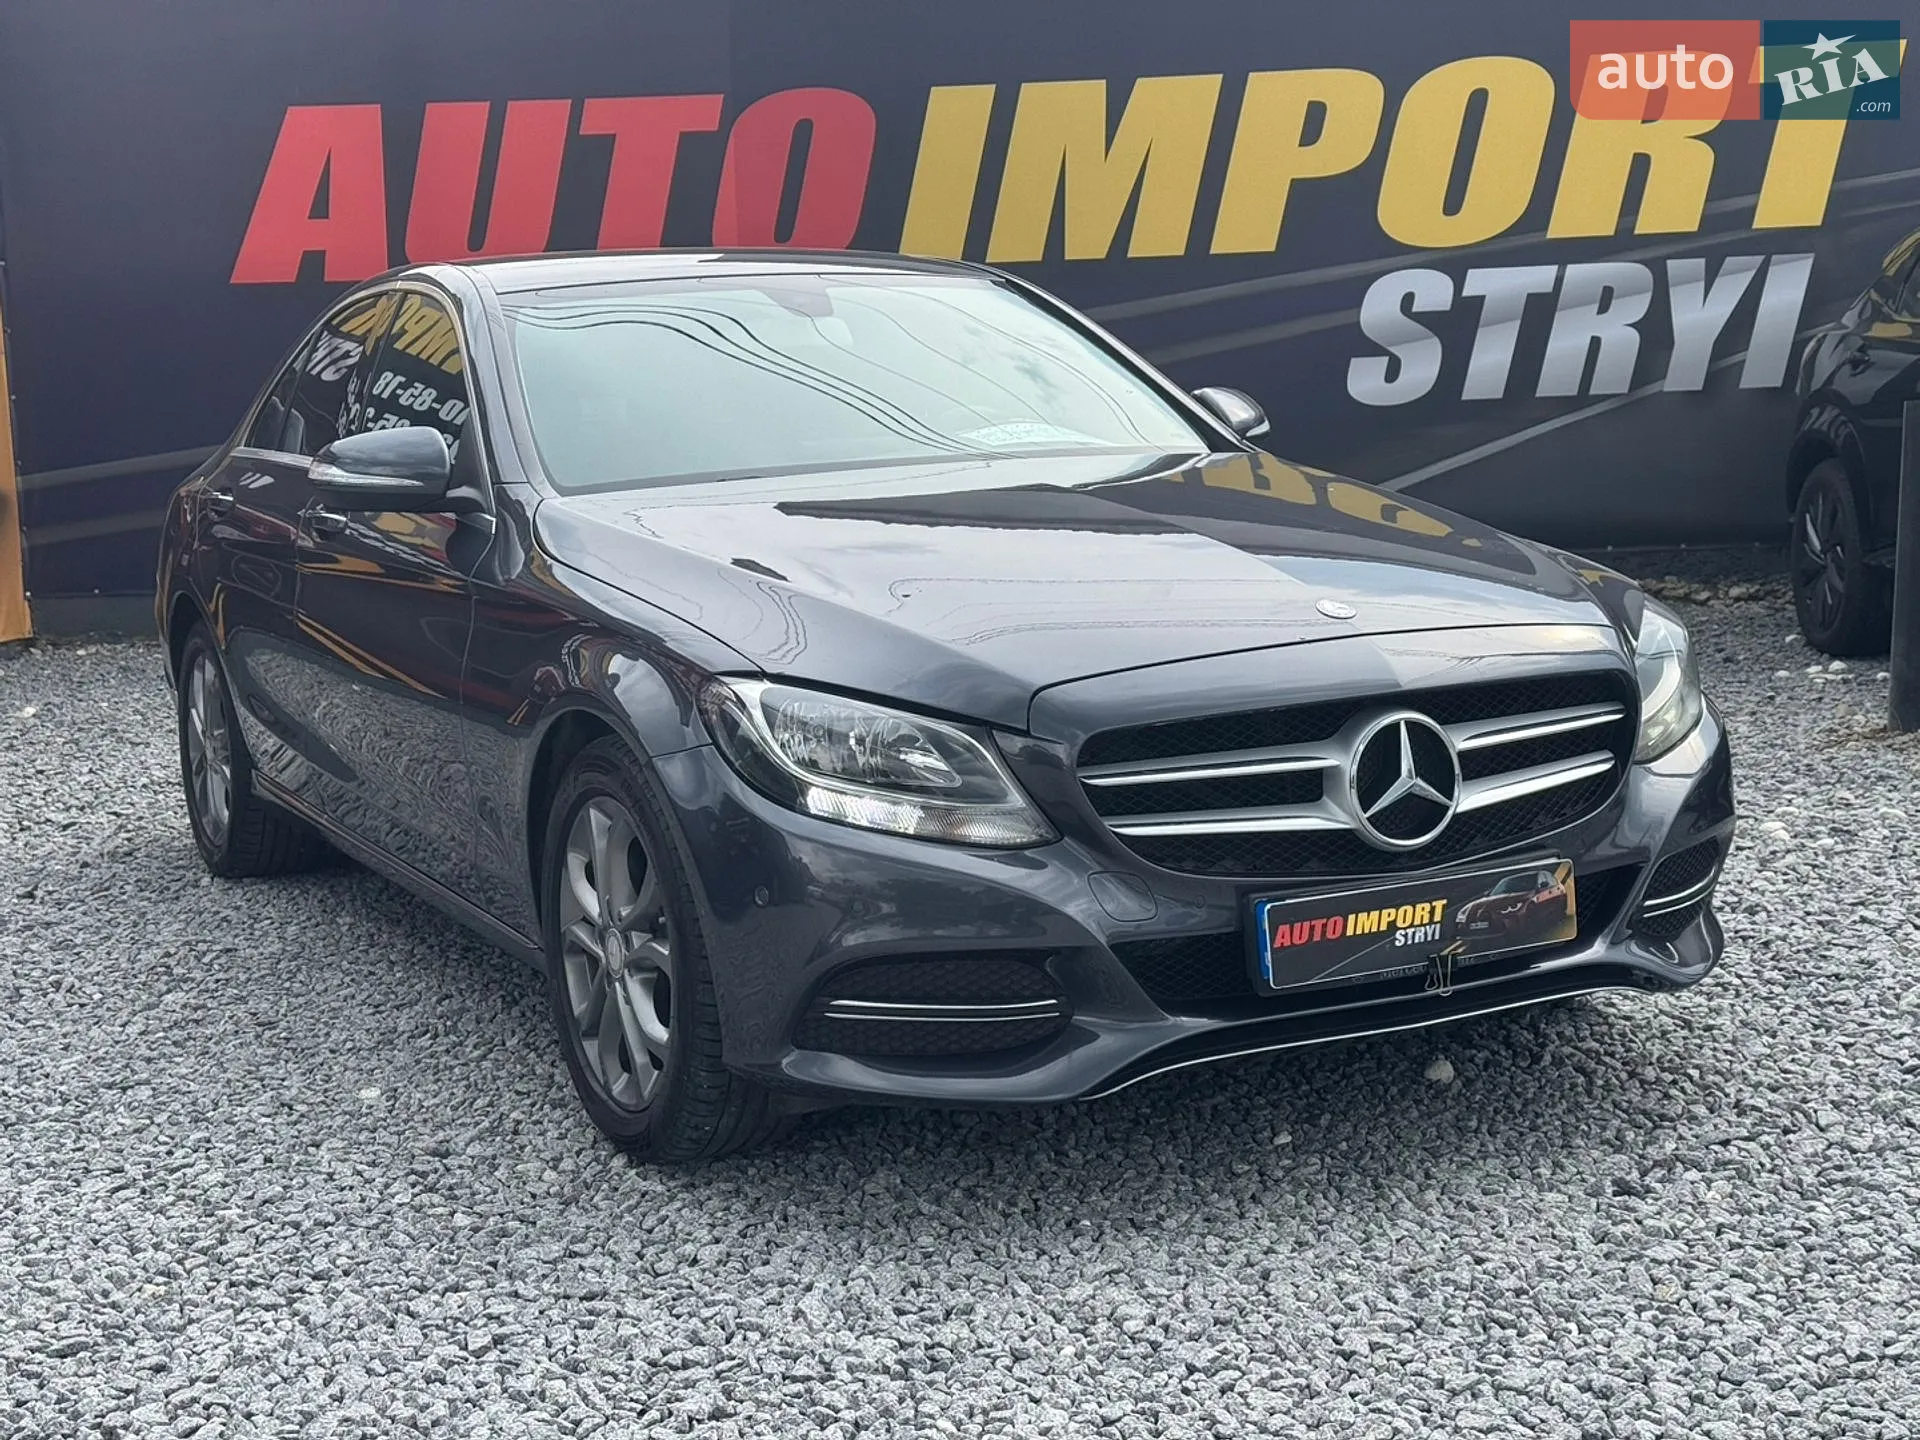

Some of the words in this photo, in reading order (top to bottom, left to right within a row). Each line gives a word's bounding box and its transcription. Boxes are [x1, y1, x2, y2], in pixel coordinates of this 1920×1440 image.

[229, 87, 877, 284] AUTO
[899, 38, 1909, 263] IMPORT
[1346, 252, 1815, 406] STRYI
[1273, 915, 1345, 948] AUTO
[1345, 899, 1448, 937] IMPORT
[1394, 922, 1441, 947] STRYI
